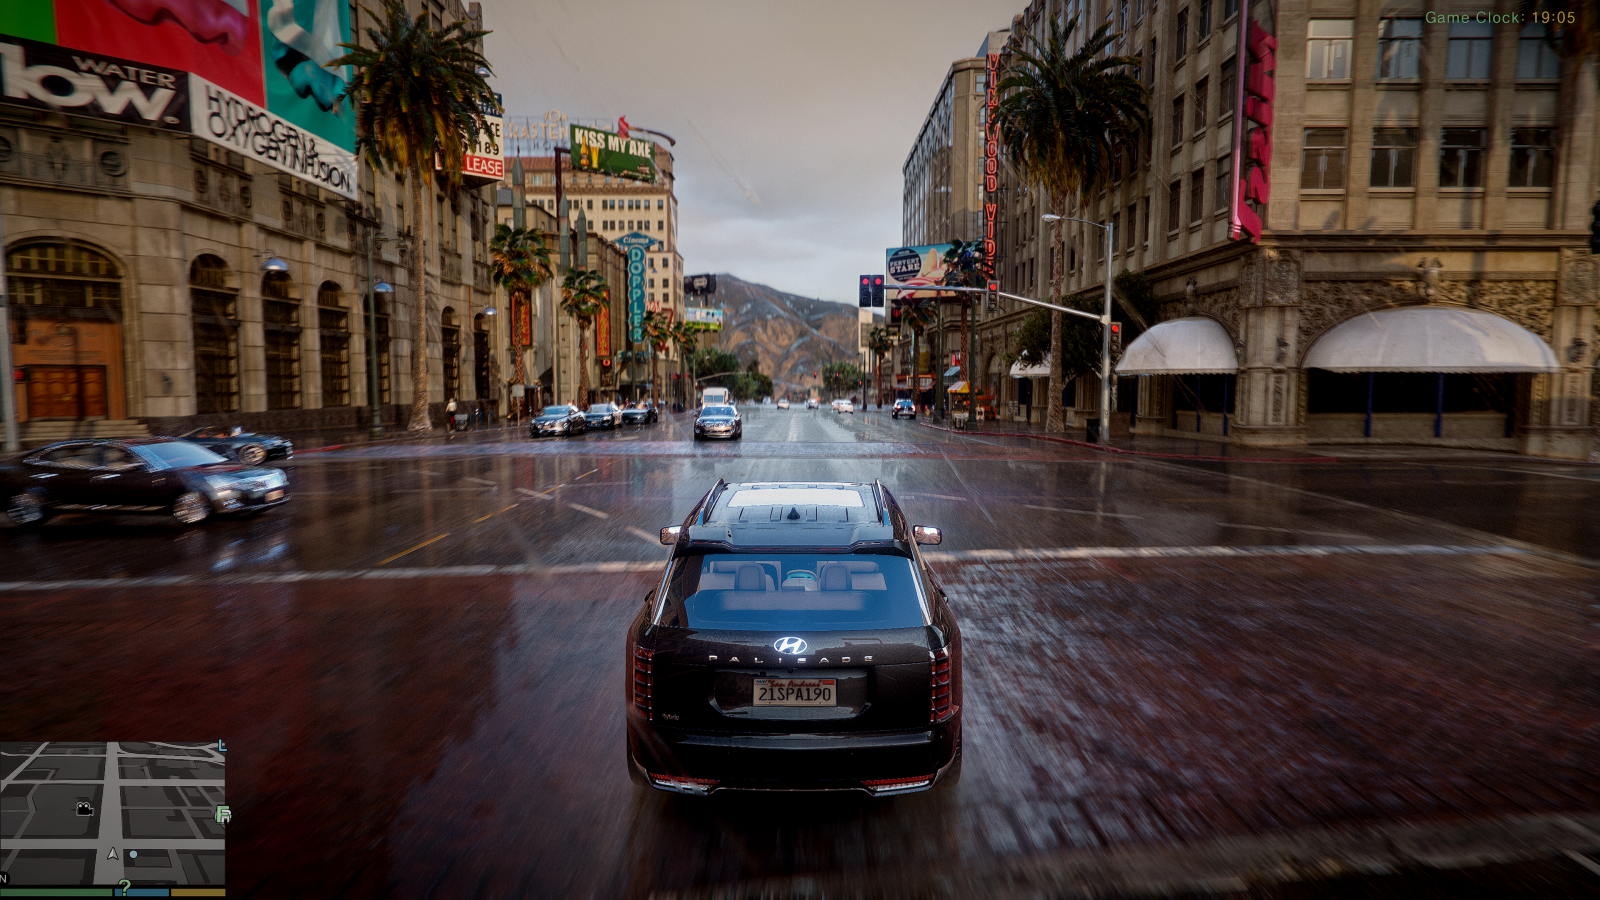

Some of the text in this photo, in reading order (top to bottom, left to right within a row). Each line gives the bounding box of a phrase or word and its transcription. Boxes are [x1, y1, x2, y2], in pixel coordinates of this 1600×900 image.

[70, 55, 178, 90] WATER
[205, 85, 319, 158] HYDROGEN &
[543, 109, 568, 123] VON
[575, 127, 606, 150] KISS
[608, 134, 627, 154] MY
[629, 139, 652, 159] AXE
[208, 111, 351, 193] OXYGEN INFUSION
[466, 157, 503, 176] LEASE
[623, 235, 650, 245] Cinema
[890, 257, 920, 267] PERVERT
[890, 263, 921, 275] STARE
[630, 248, 644, 341] DOPPLER
[708, 654, 874, 664] PALISADE
[769, 679, 786, 688] San
[787, 679, 822, 688] Andreas
[758, 687, 832, 702] 21SPA190
